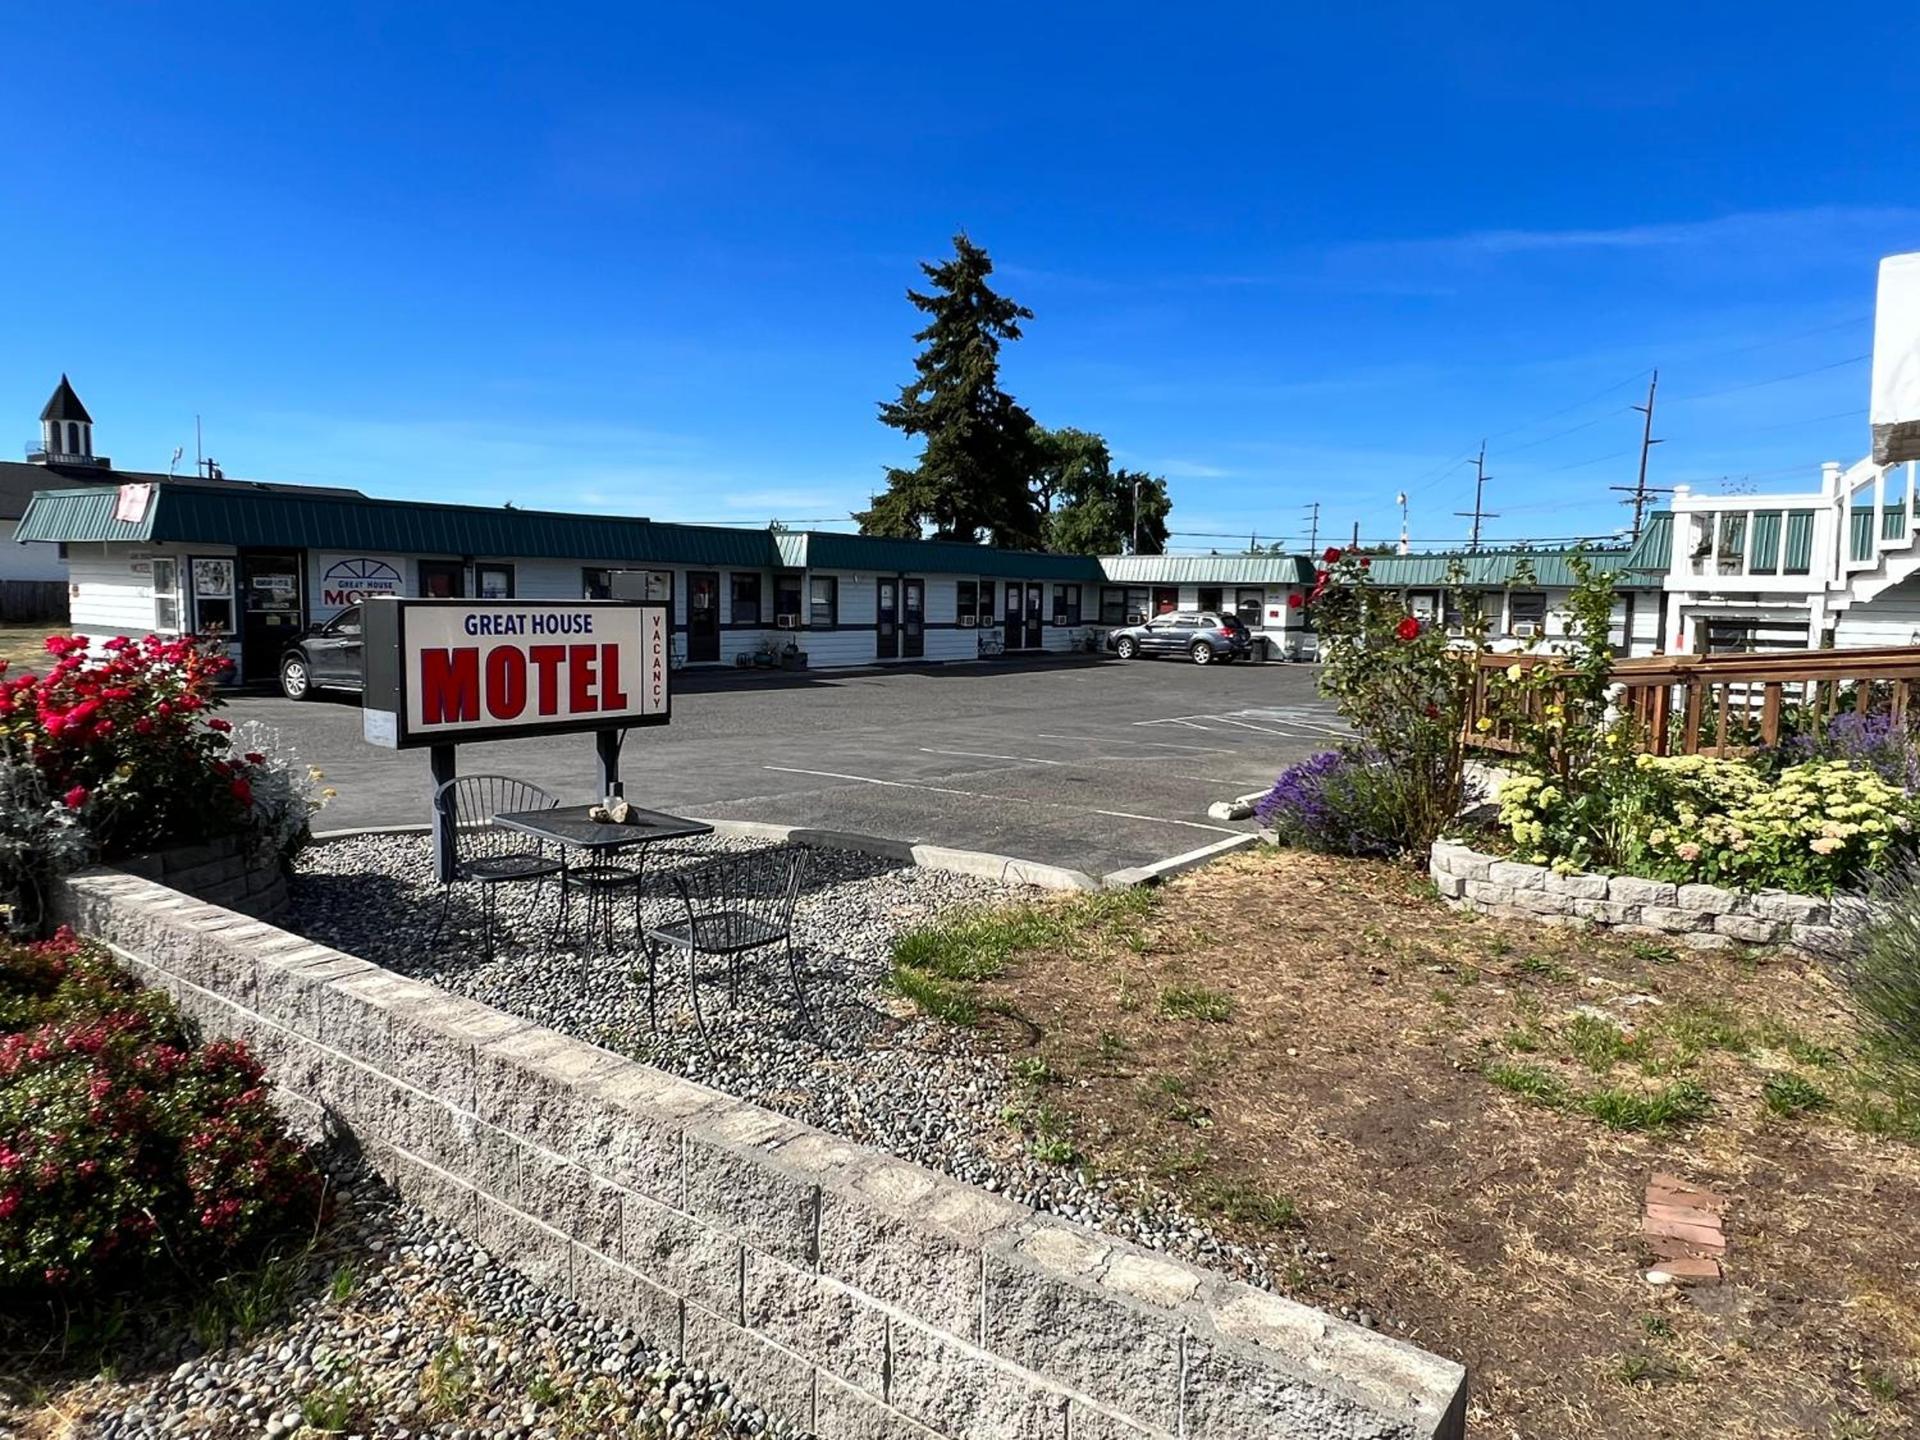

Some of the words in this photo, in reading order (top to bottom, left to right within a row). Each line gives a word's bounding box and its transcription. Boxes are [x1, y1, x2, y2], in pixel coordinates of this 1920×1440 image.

[464, 614, 527, 636] GREAT
[532, 613, 593, 635] HOUSE
[652, 616, 662, 708] VACANCY
[420, 643, 628, 725] MOTEL
